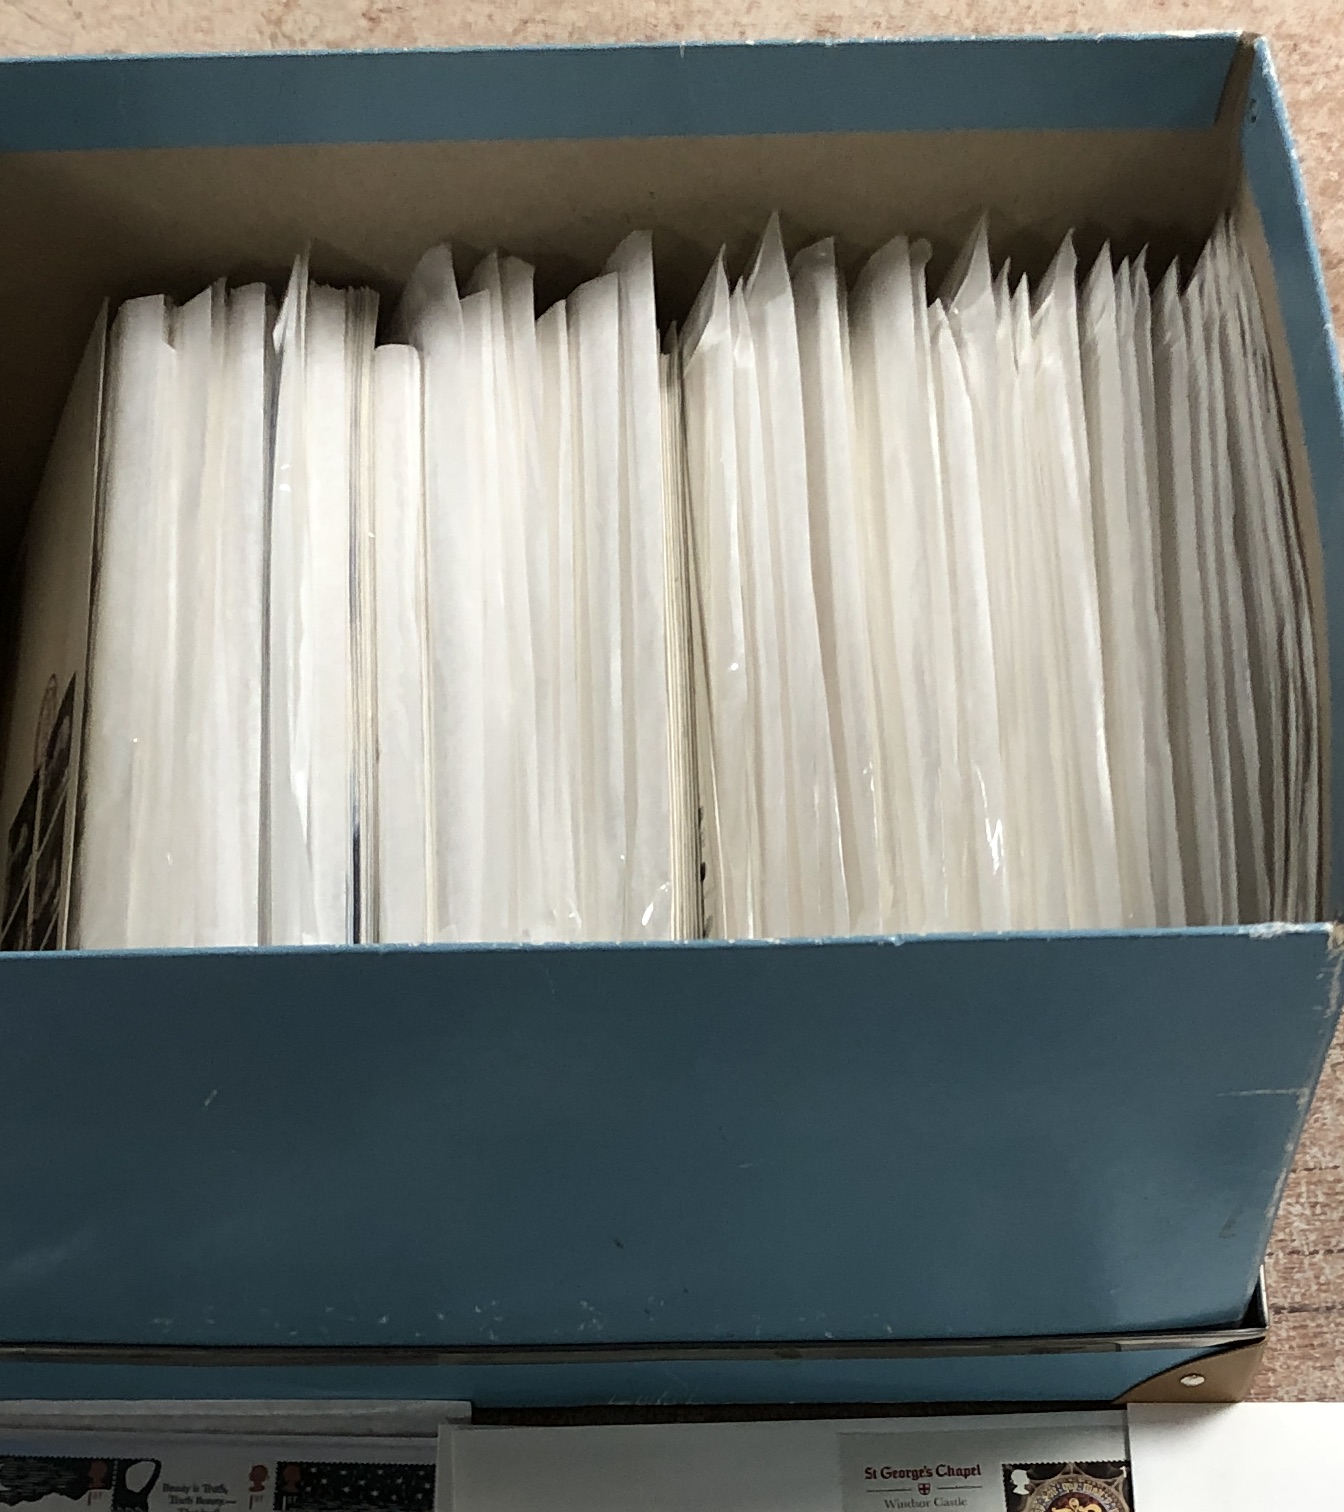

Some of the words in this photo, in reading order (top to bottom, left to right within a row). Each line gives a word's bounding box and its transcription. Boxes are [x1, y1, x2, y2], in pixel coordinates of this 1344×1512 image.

[864, 1467, 879, 1480] St
[880, 1466, 933, 1483] George's
[935, 1464, 982, 1482] Chapel
[884, 1498, 931, 1510] Windsor
[933, 1496, 969, 1509] Castle
